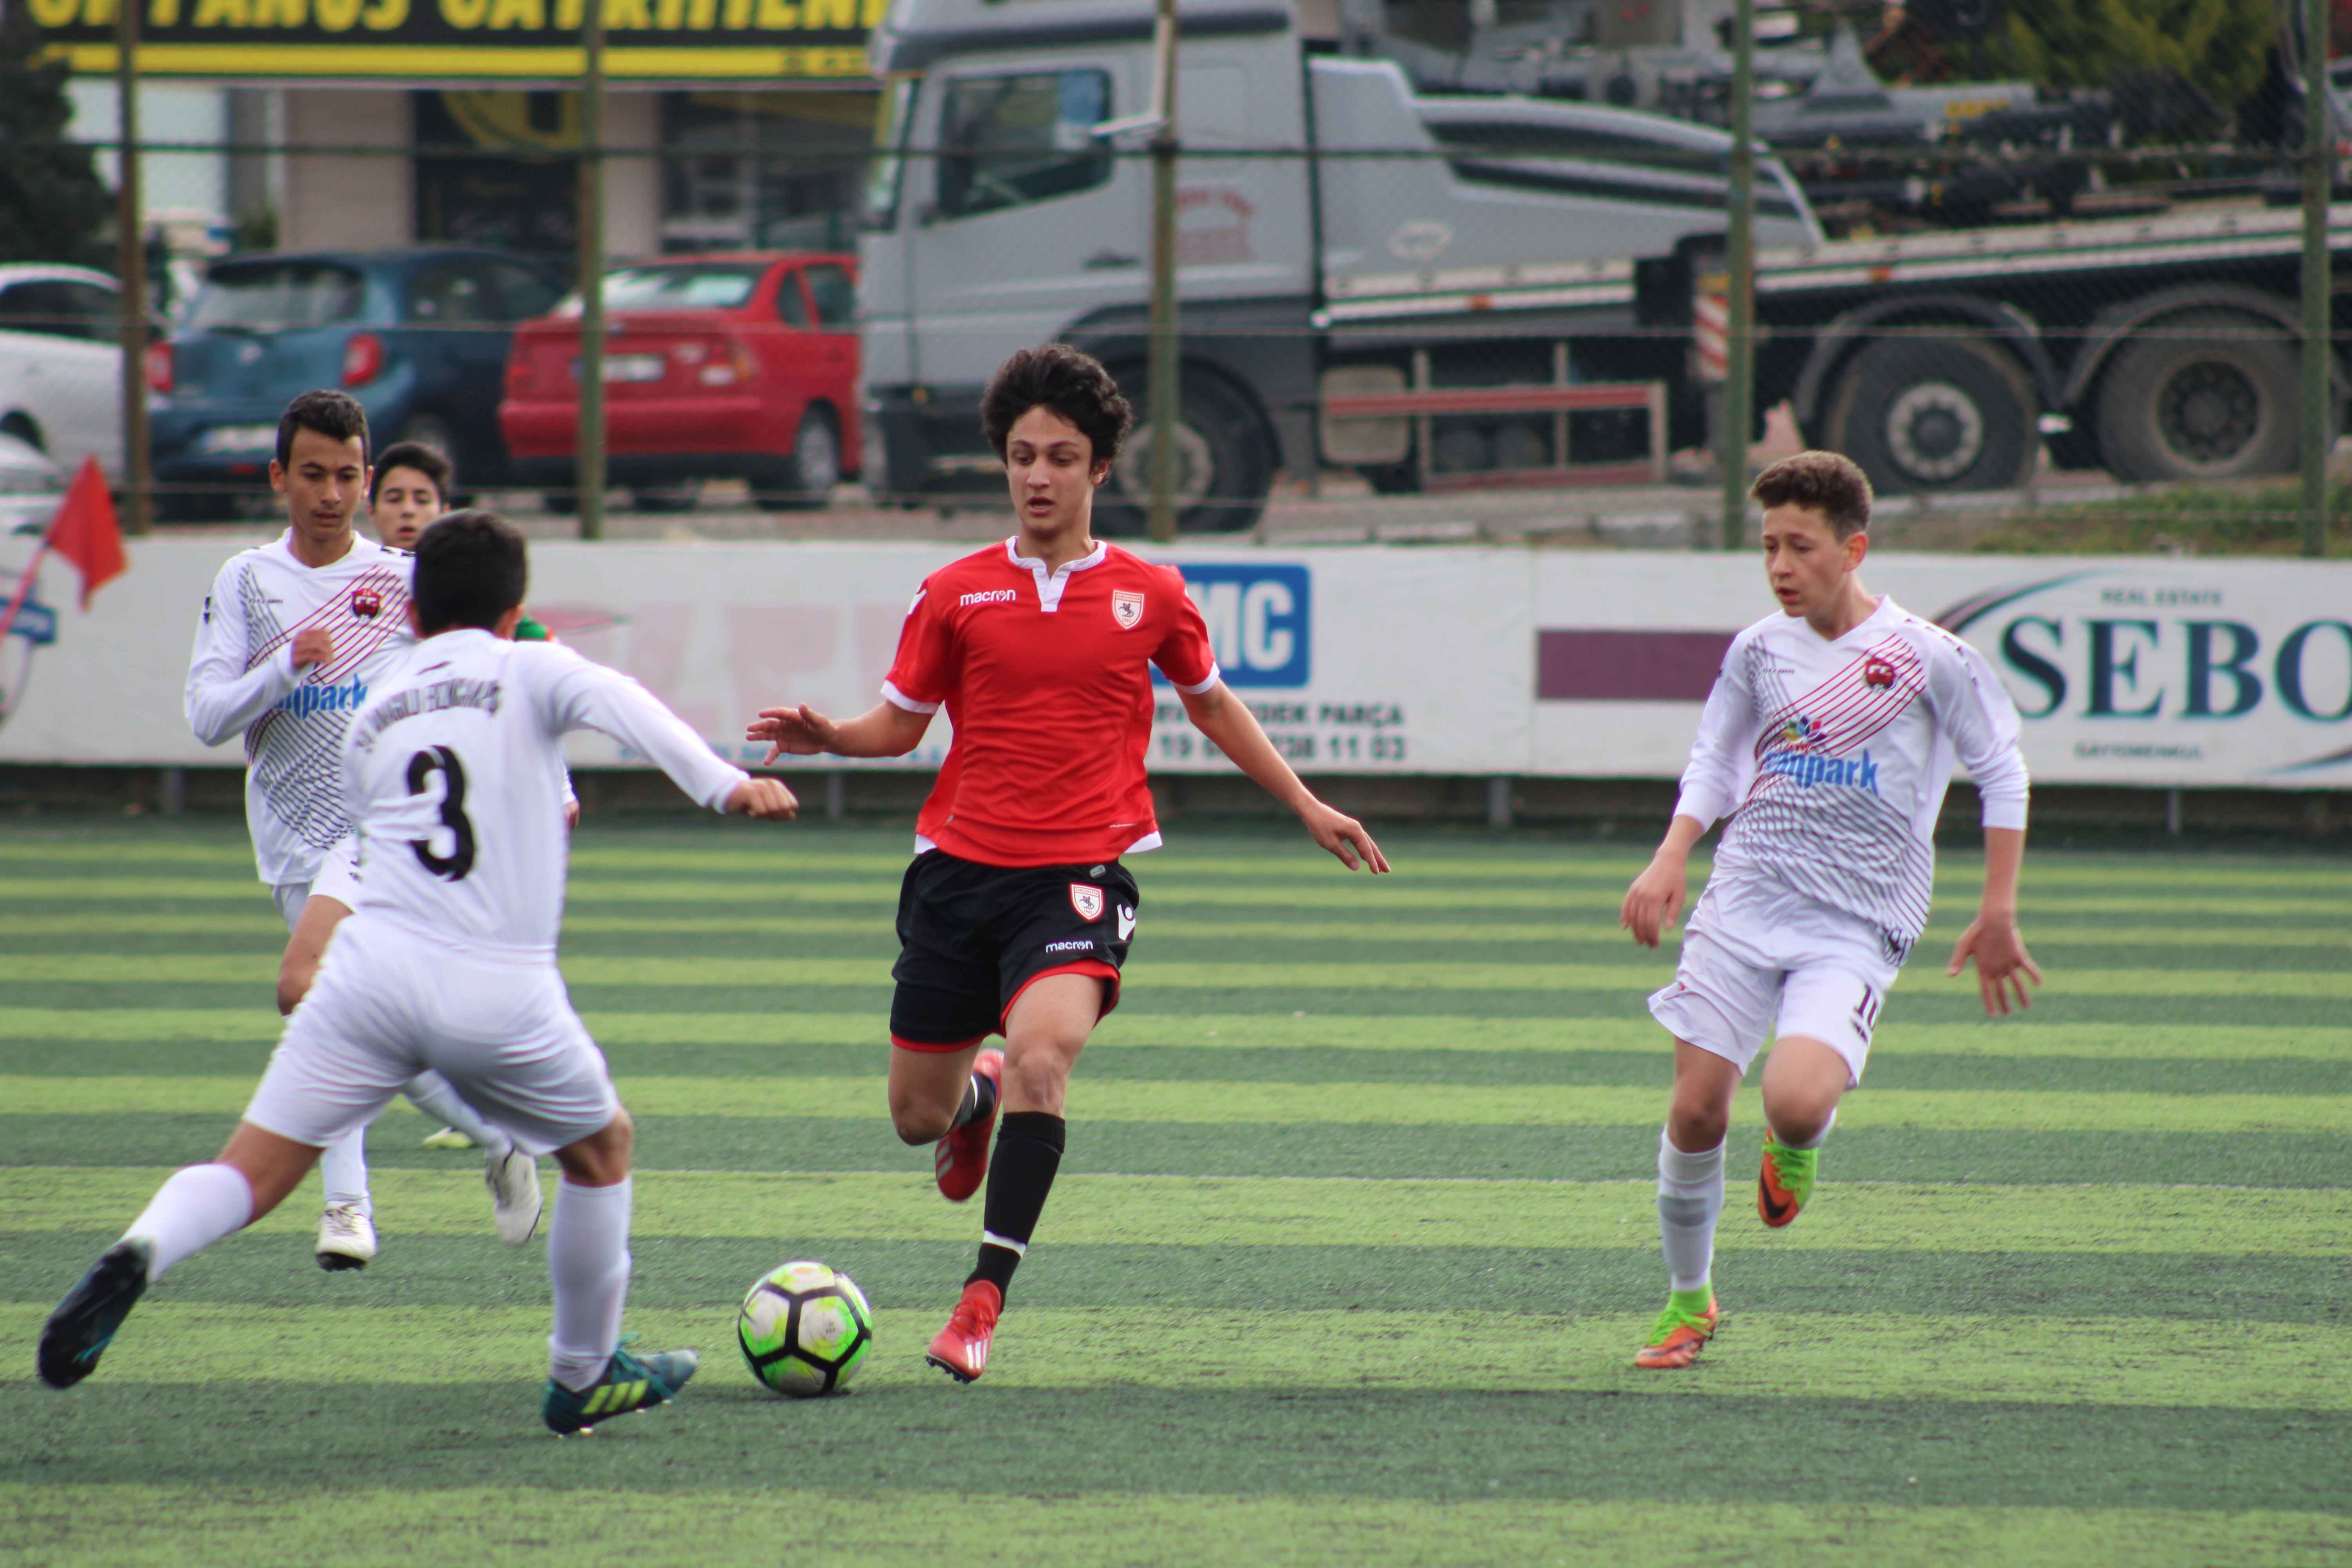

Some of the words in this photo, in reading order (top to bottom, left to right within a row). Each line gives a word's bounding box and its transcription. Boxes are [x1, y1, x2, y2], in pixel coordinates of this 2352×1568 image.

[960, 589, 1016, 606] macron
[2100, 588, 2149, 606] REAL
[2155, 589, 2222, 607] ESTATE
[2000, 615, 2352, 723] SEBO
[1319, 703, 1404, 730] PARÇA
[1329, 735, 1357, 759] 11
[1369, 735, 1405, 760] 03
[407, 744, 474, 882] 3
[1075, 887, 1098, 896] SAMSUNSPOR
[1045, 940, 1094, 953] macron
